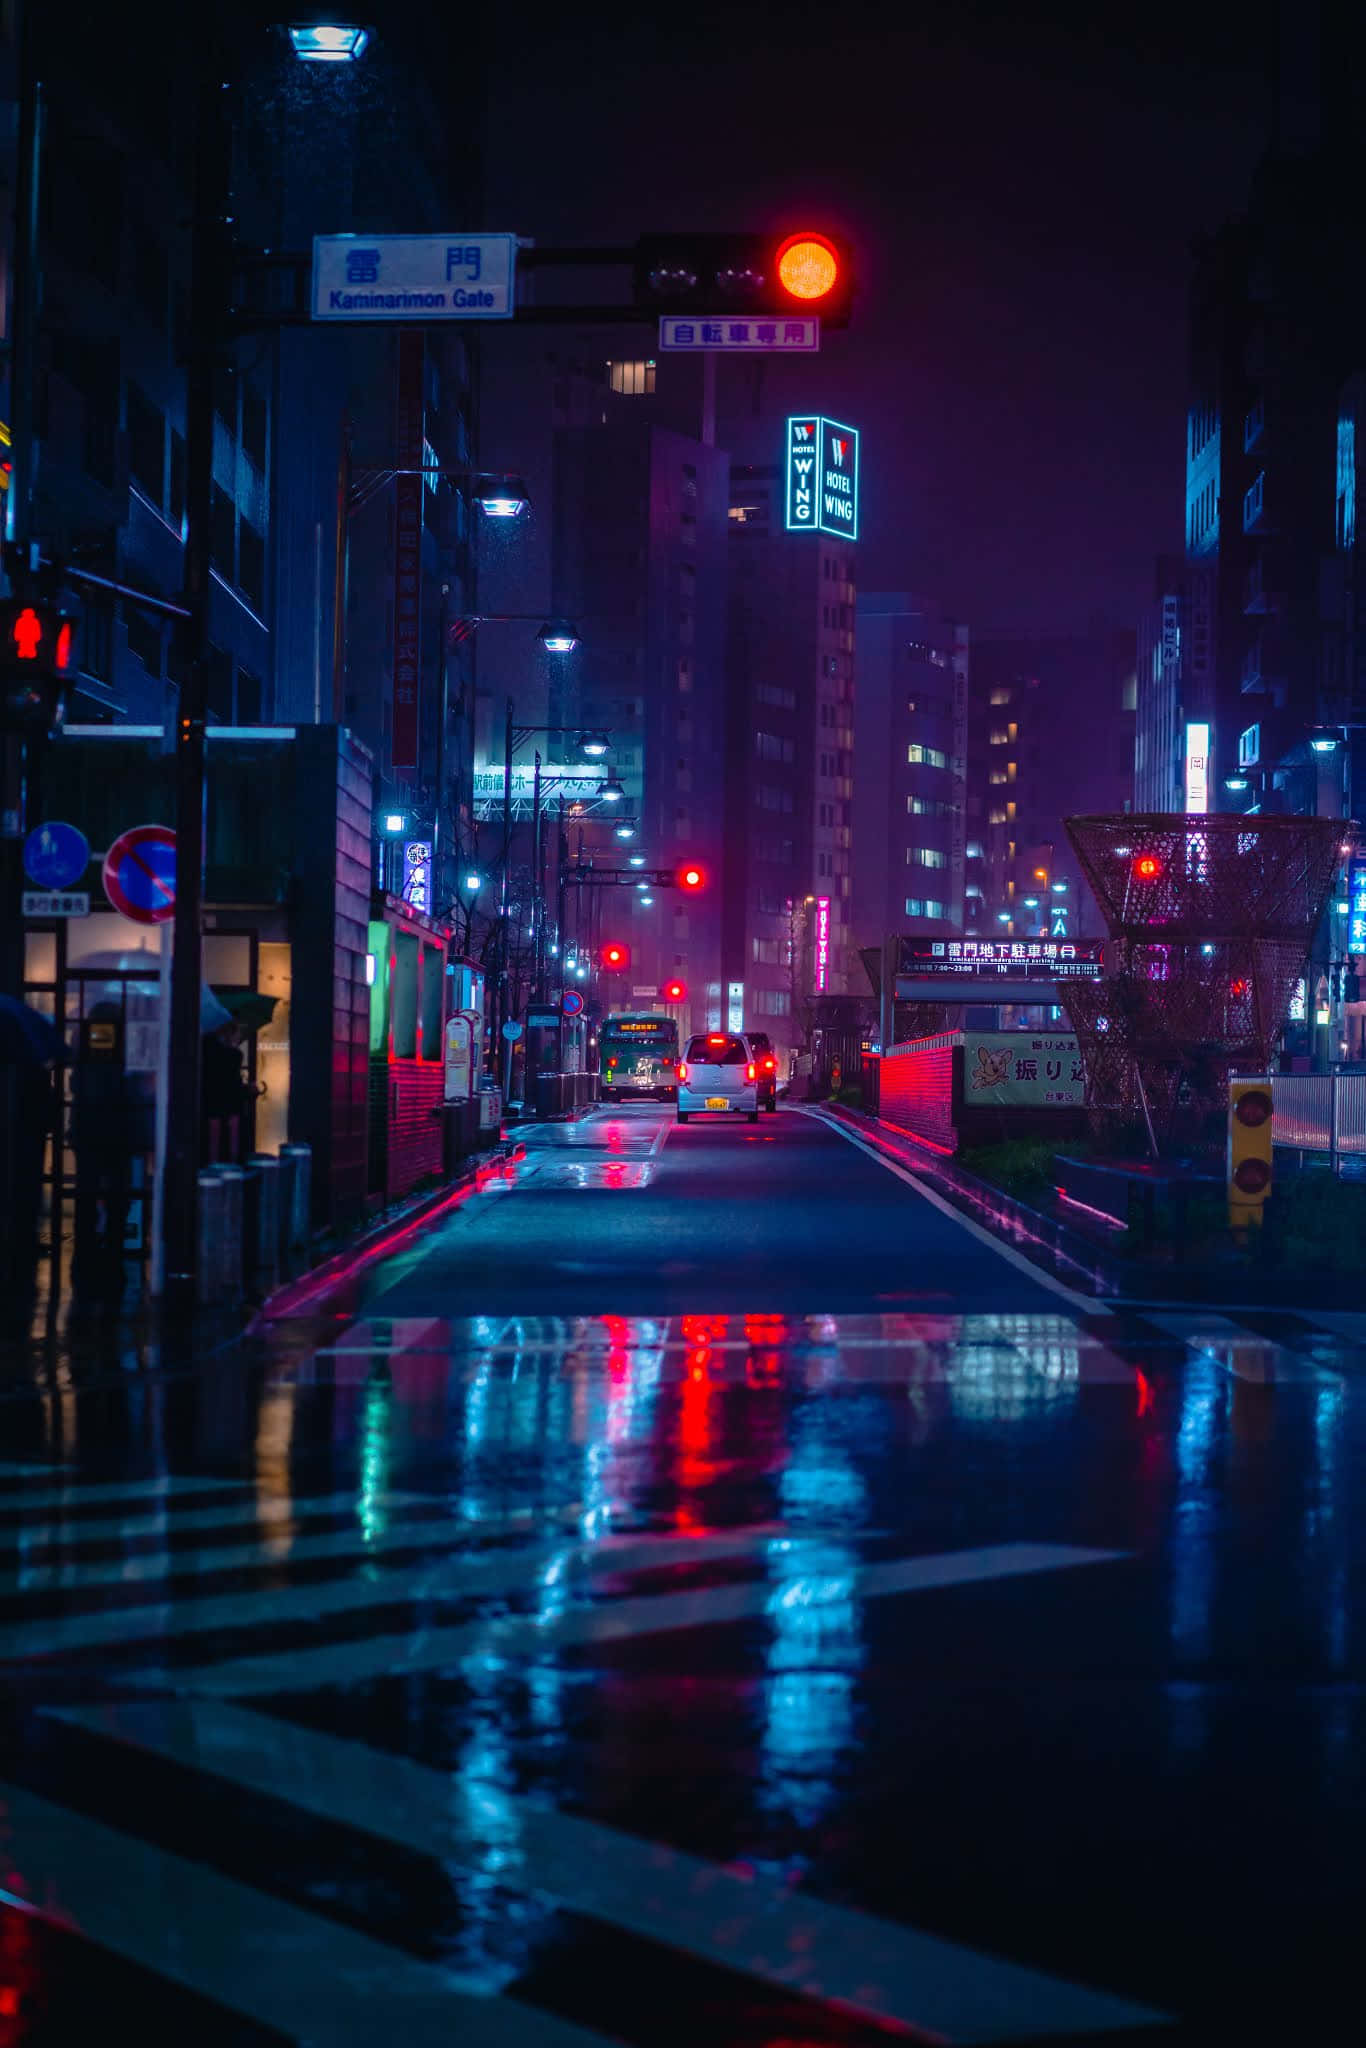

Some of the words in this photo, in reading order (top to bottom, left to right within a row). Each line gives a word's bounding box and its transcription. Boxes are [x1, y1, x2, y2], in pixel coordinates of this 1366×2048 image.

[346, 247, 481, 283] 雷門
[329, 291, 445, 309] Kaminarimon
[453, 288, 494, 308] Gate
[674, 324, 805, 344] 自転車専用
[792, 446, 815, 454] HOTEL
[794, 459, 813, 519] WING
[826, 471, 851, 494] HOTEL
[824, 494, 852, 520] WING
[1053, 919, 1067, 936] A
[948, 943, 1056, 958] 雷門地下駐車場
[997, 964, 1007, 973] IN
[1016, 1060, 1084, 1081] 振り込
